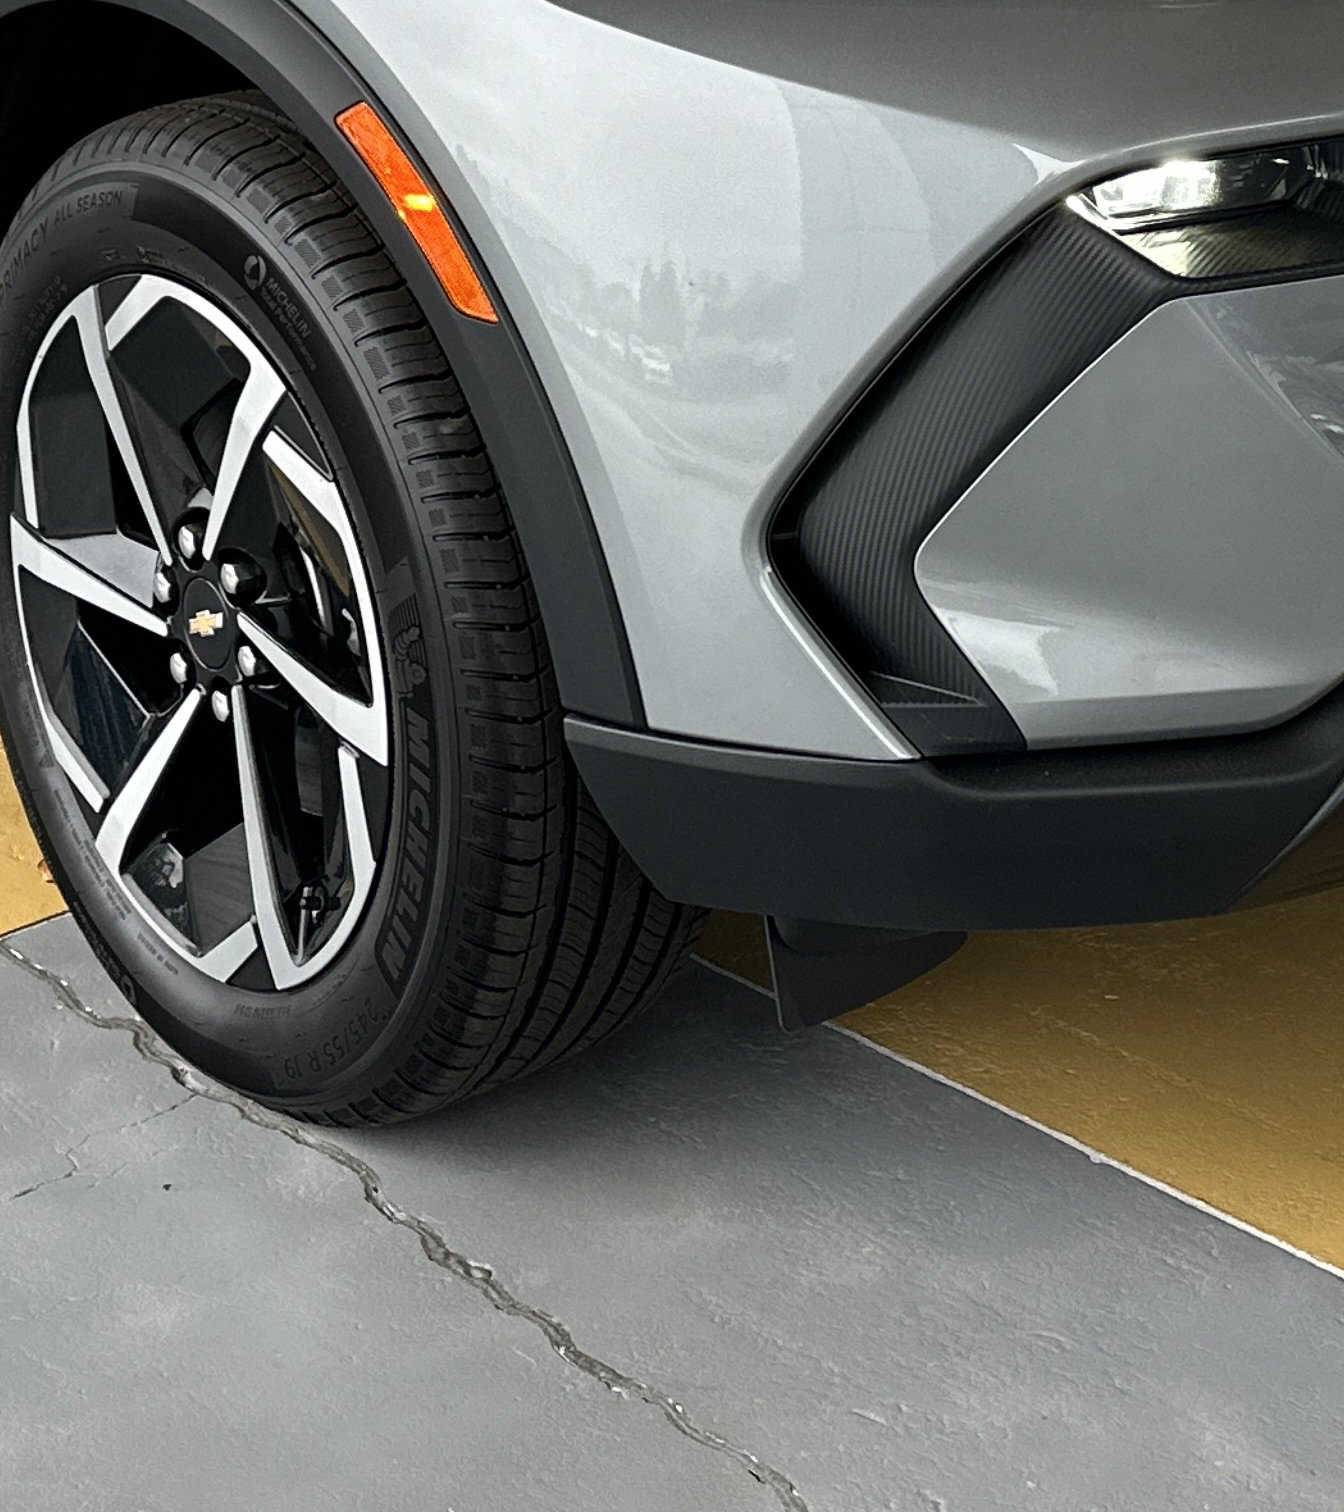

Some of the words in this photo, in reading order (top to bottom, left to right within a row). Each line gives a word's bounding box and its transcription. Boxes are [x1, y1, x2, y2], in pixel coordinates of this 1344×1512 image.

[54, 203, 73, 226] ALL
[76, 190, 123, 214] SEASON
[265, 276, 312, 339] MICHELIN
[380, 706, 431, 982] MICHELIN
[323, 996, 378, 1066] 245/55
[284, 1054, 304, 1080] 19
[307, 1048, 322, 1073] R
